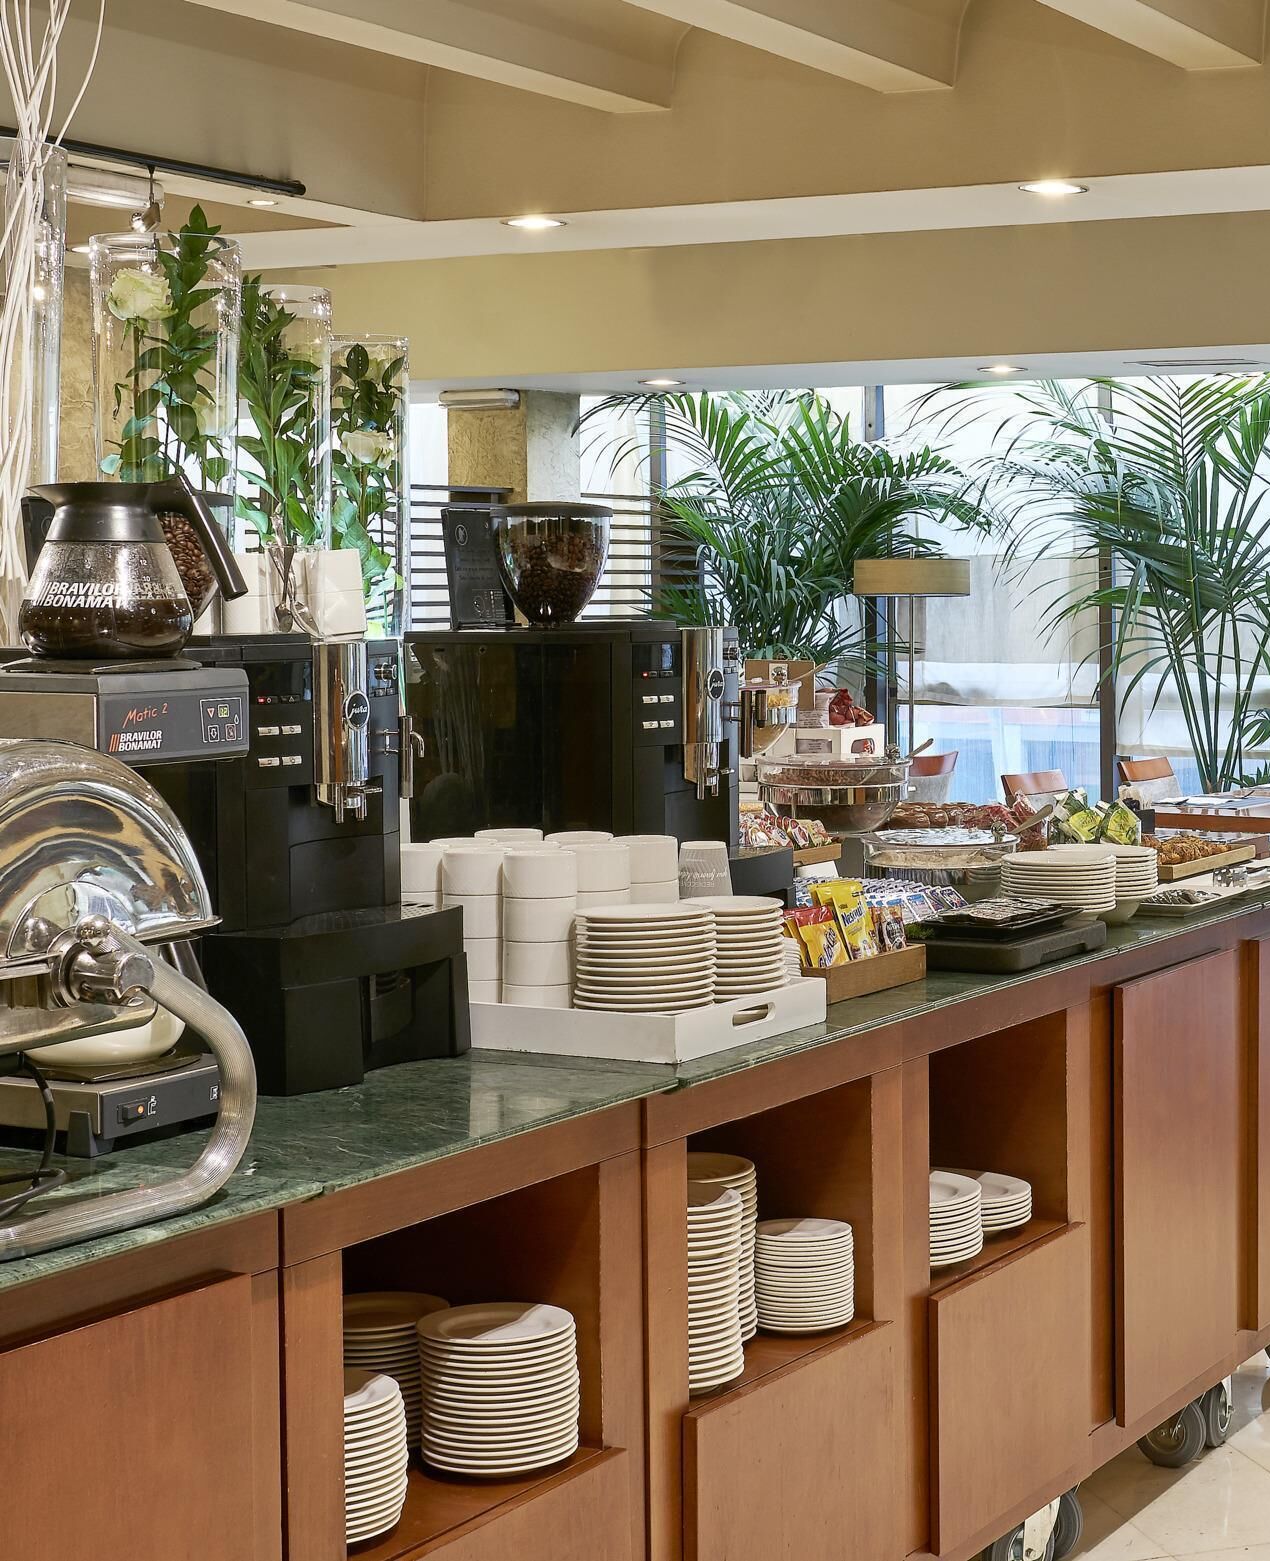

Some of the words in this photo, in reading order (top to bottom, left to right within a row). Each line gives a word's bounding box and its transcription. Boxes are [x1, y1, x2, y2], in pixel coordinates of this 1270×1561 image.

[122, 705, 158, 729] Matic
[161, 702, 168, 714] 2
[120, 731, 163, 742] BRAVILOR
[118, 739, 162, 752] BONAMAT
